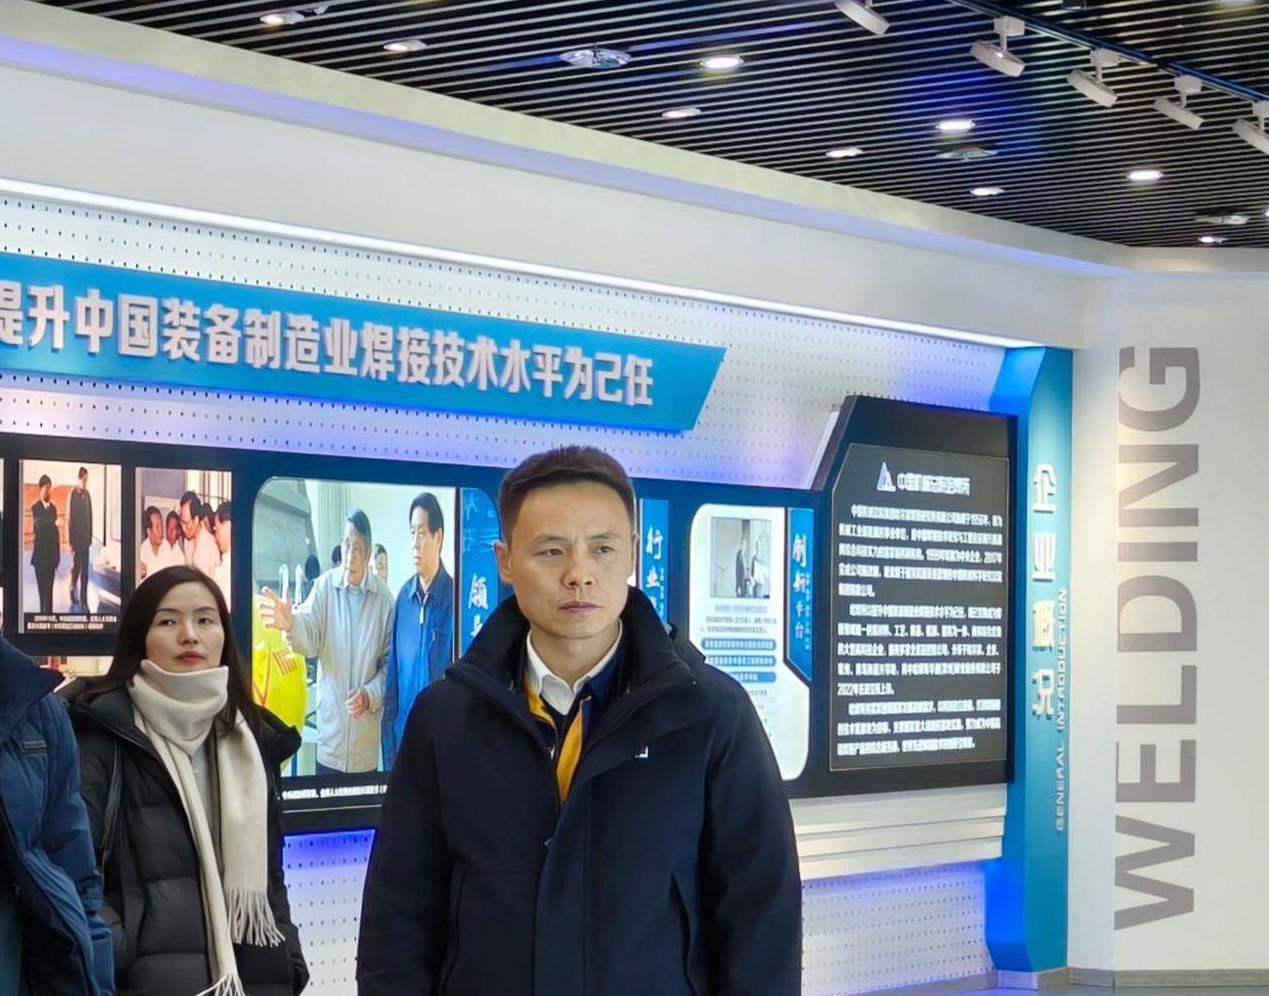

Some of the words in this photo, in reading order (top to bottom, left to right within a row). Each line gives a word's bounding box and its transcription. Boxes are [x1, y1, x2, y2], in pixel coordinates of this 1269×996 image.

[1056, 587, 1068, 733] INTRODUCTION
[1113, 345, 1201, 931] WELDING
[1055, 740, 1066, 833] GENERAL
